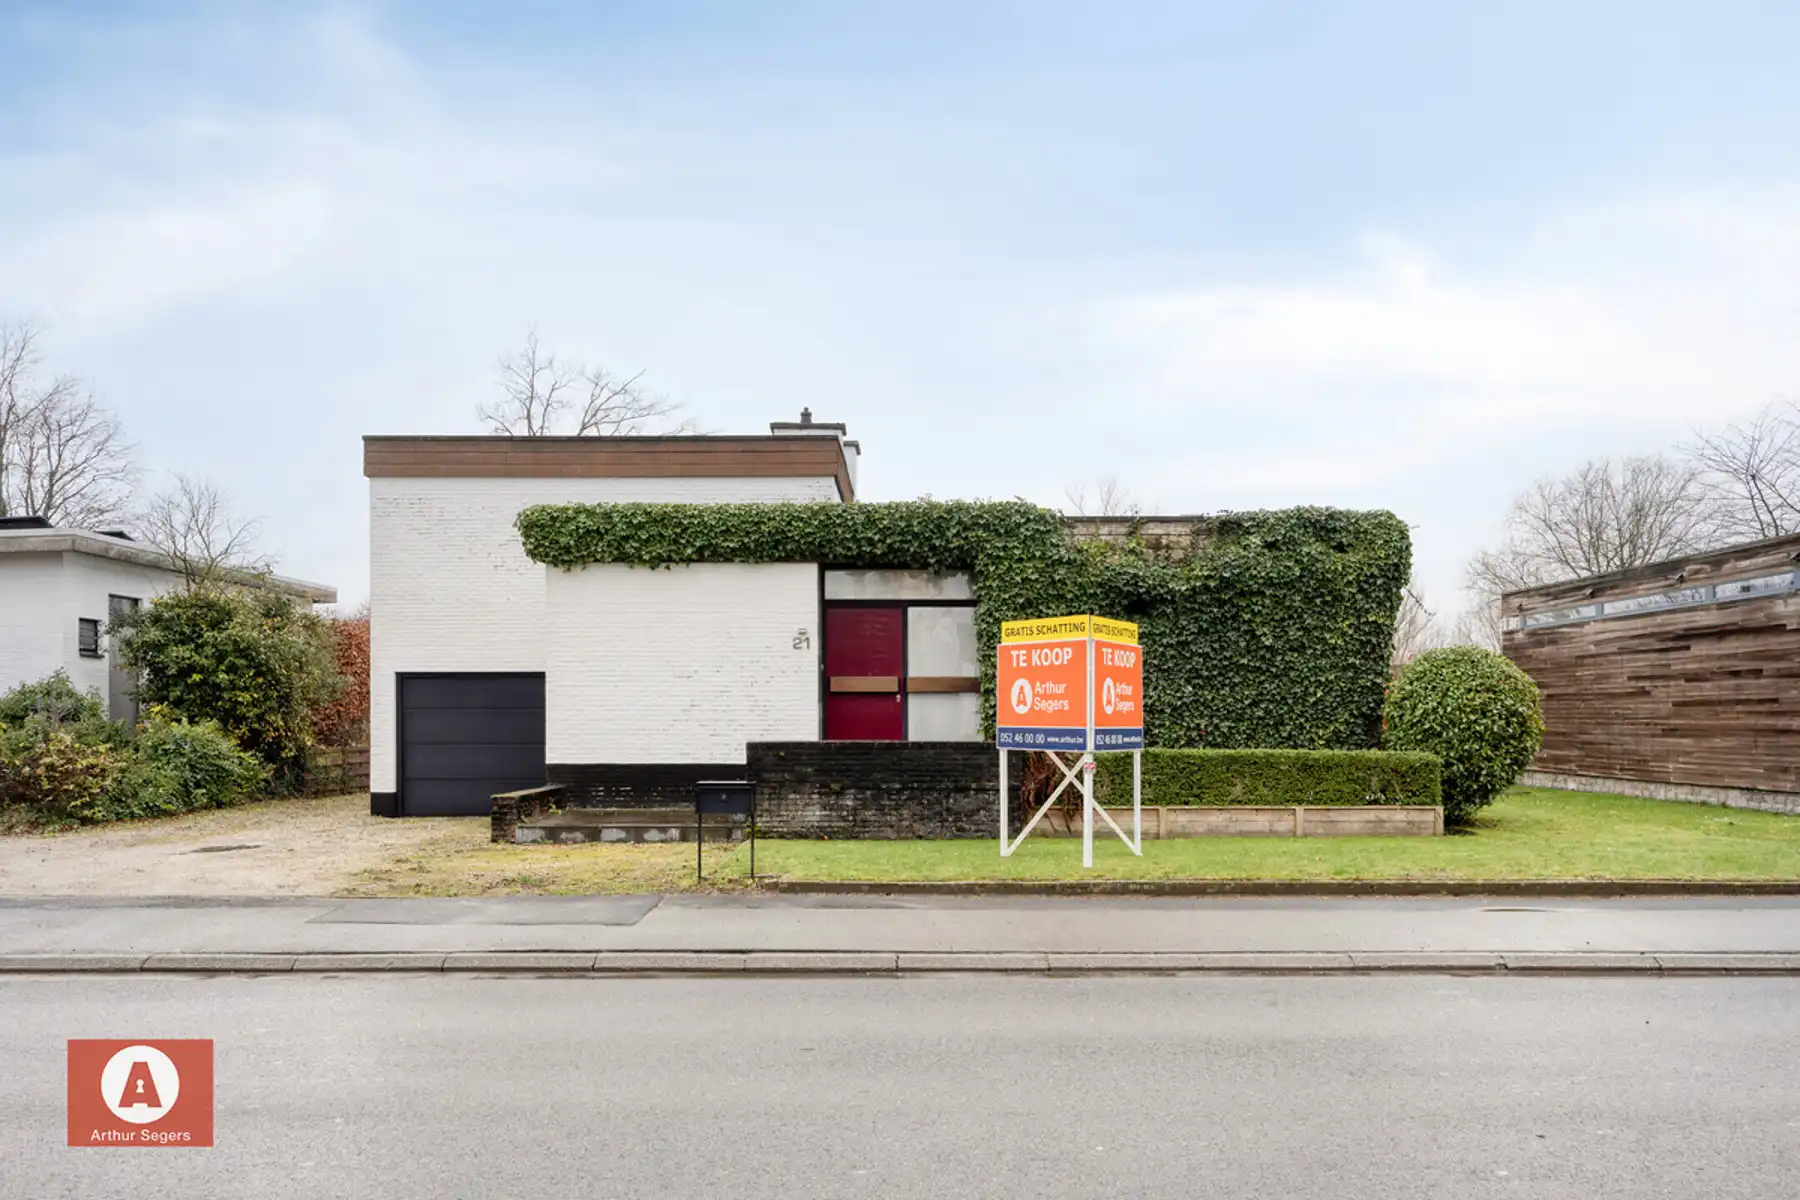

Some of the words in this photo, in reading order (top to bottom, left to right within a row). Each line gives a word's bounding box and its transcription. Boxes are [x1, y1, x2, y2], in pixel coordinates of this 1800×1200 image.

[1005, 625, 1034, 637] GRATIS
[1036, 622, 1086, 635] SCHATTING
[793, 637, 810, 650] 21
[1010, 650, 1027, 667] TE
[1032, 647, 1073, 666] KOOP
[1102, 647, 1112, 666] TE
[1114, 649, 1136, 668] KOOP
[1034, 681, 1066, 694] Arthur
[1034, 697, 1069, 713] Segers
[1000, 732, 1013, 743] 052
[1014, 733, 1024, 743] 46
[1025, 733, 1034, 743] 00
[1035, 733, 1044, 743] 00
